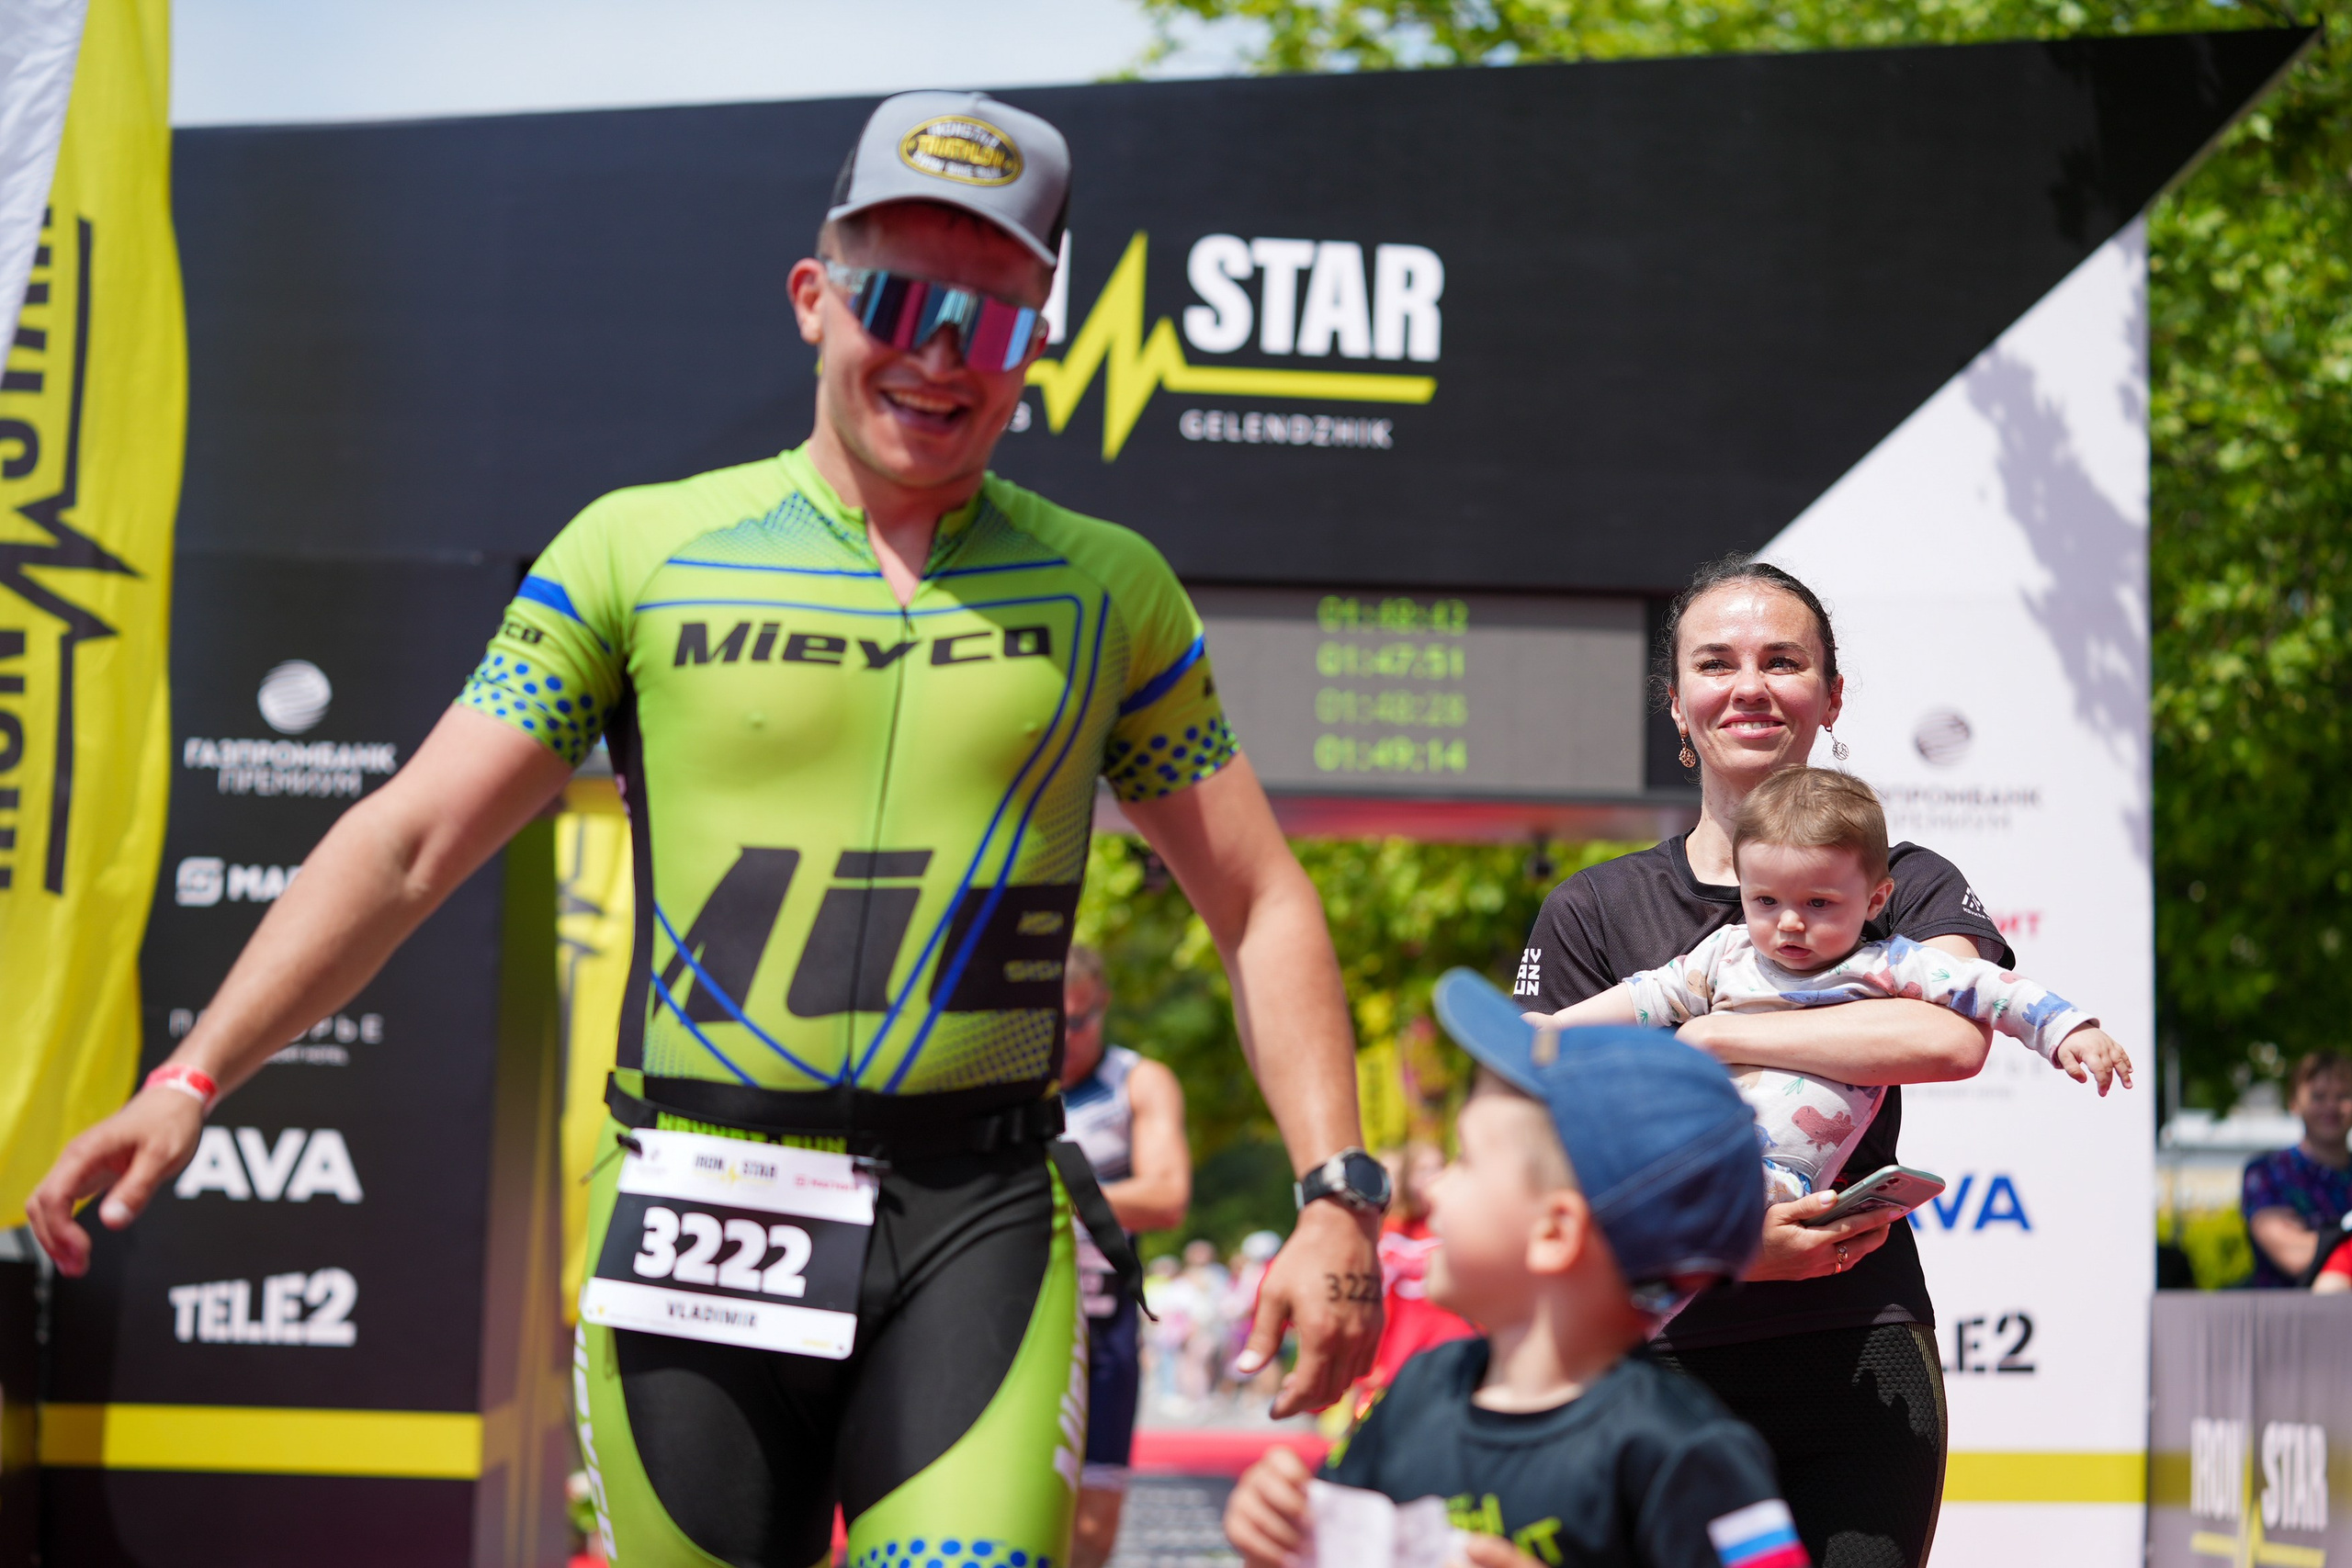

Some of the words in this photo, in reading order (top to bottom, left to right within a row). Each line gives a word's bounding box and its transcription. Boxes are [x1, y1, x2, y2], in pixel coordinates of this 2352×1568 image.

[1182, 232, 1445, 363] STAR
[1179, 409, 1394, 450] GELENDZHIK
[184, 737, 397, 773] ГАЗПРОМБАНК
[1513, 980, 1539, 996] UN
[1517, 964, 1540, 980] AZ
[175, 1124, 365, 1204] AVA
[632, 1205, 813, 1299] 3222
[167, 1266, 359, 1348] TELE2
[666, 1302, 759, 1329] VLADIMIR
[2259, 1420, 2329, 1532] STAR
